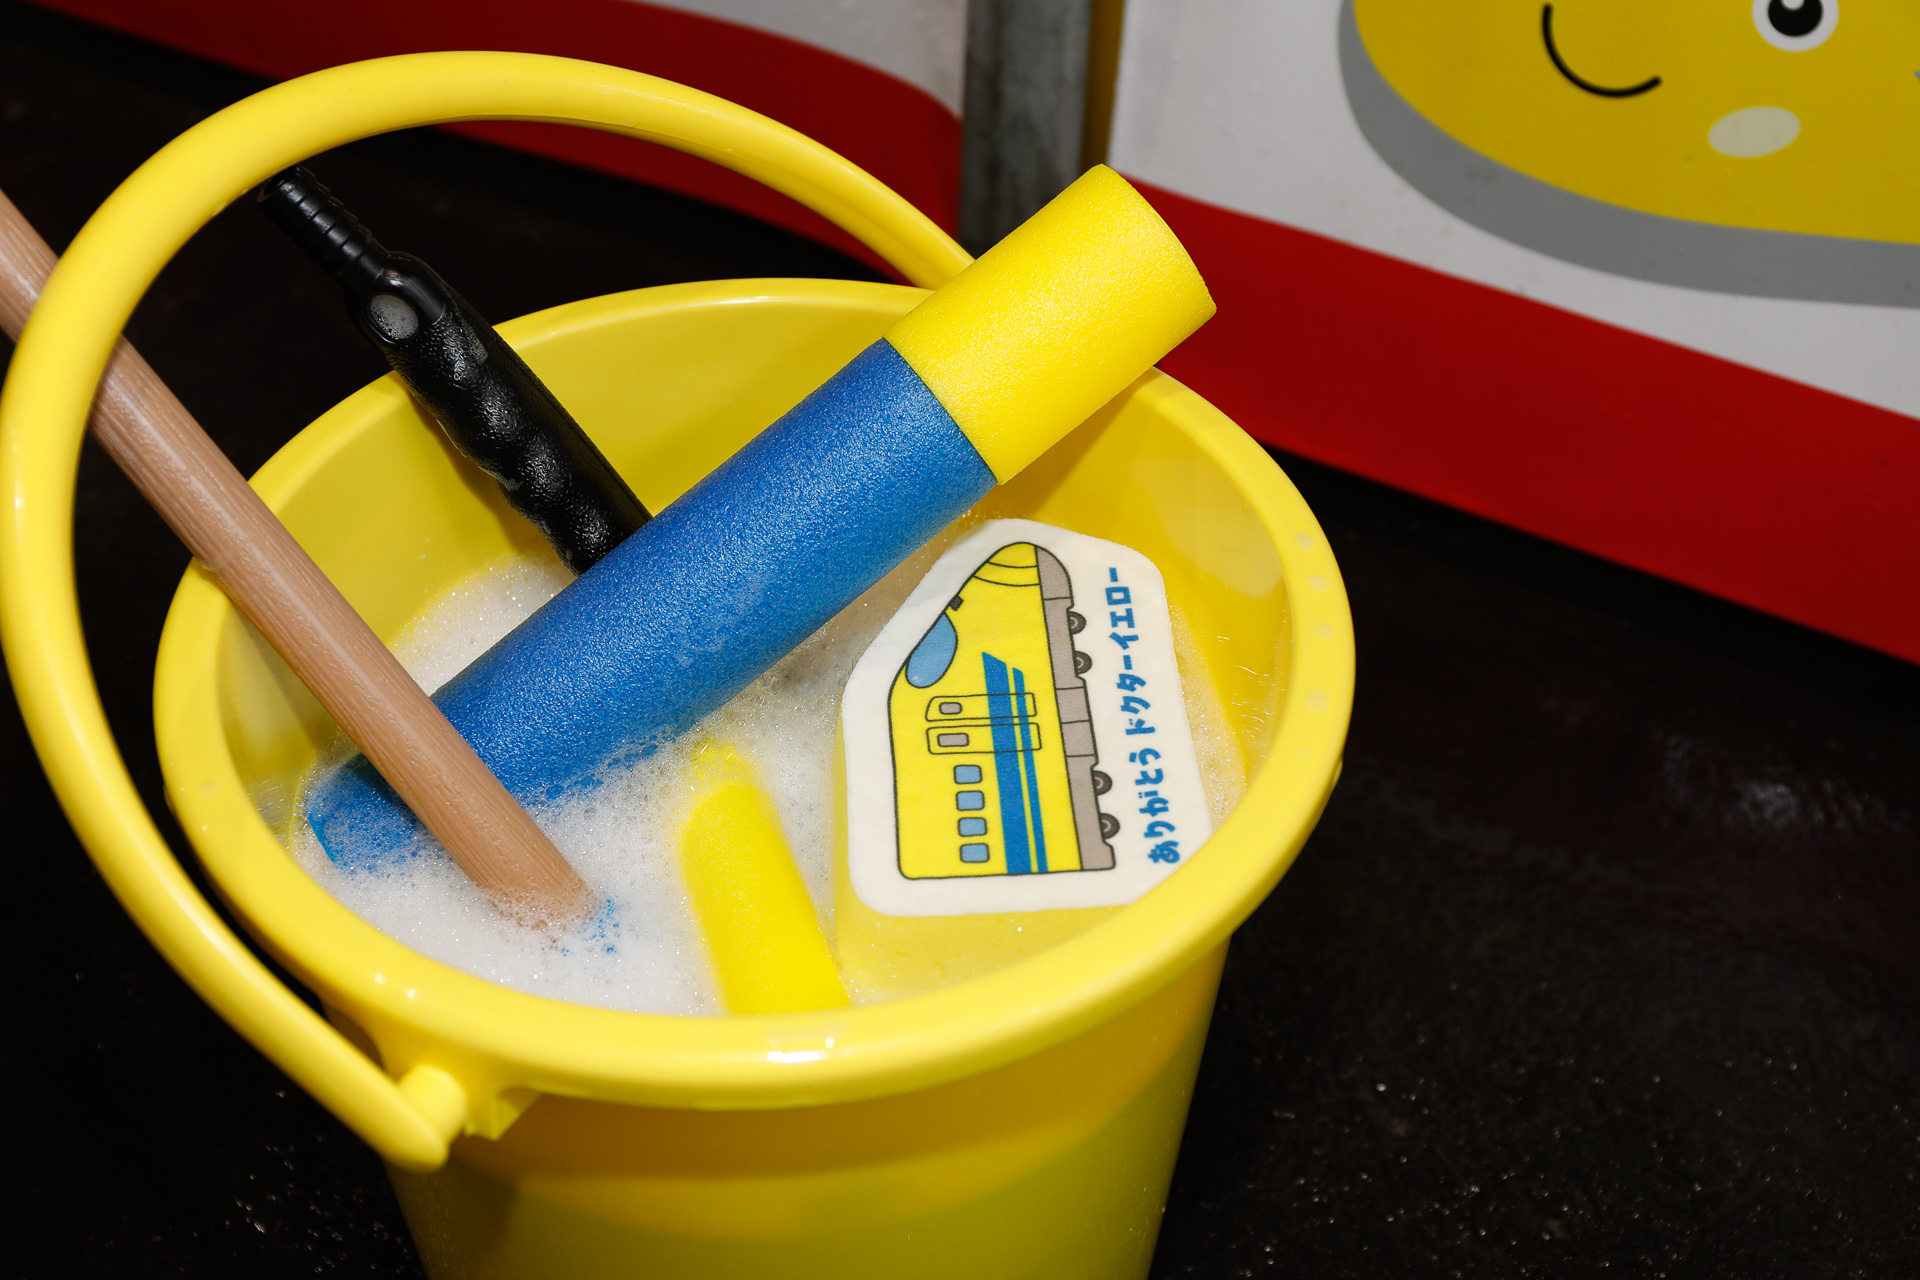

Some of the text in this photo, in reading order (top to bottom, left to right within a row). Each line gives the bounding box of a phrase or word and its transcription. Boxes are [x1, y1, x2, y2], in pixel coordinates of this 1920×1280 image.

[1104, 567, 1181, 864] ありがとう ドクターイエロー
